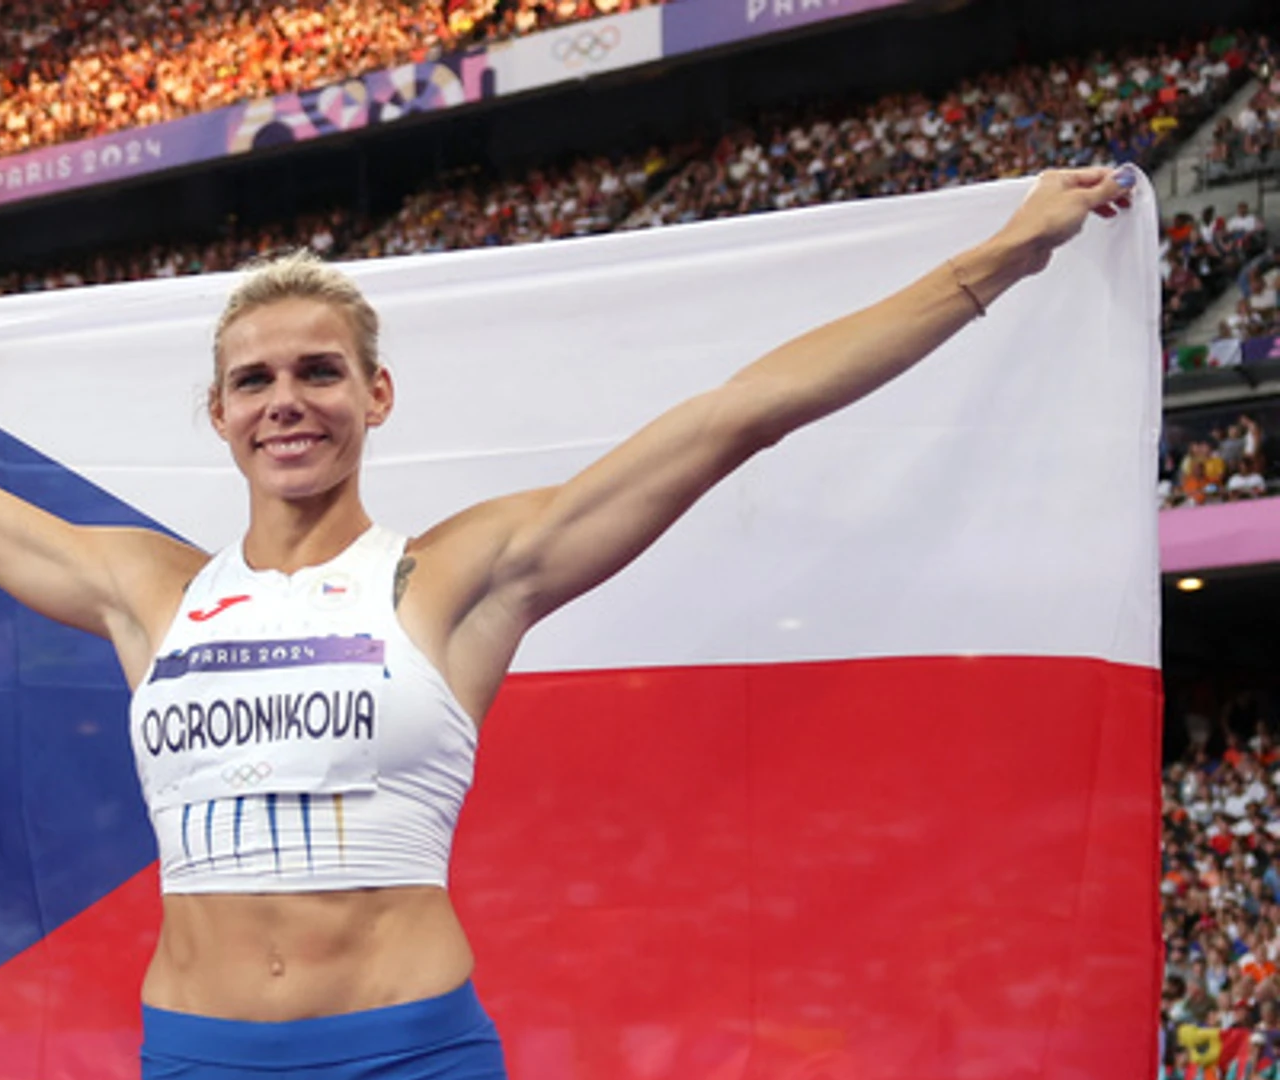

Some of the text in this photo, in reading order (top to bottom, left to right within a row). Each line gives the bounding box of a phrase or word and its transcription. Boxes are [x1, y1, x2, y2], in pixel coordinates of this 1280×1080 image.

[81, 139, 162, 174] 2024
[189, 646, 315, 665] PARIS 2024
[142, 690, 375, 757] OGRODNIKOVA
